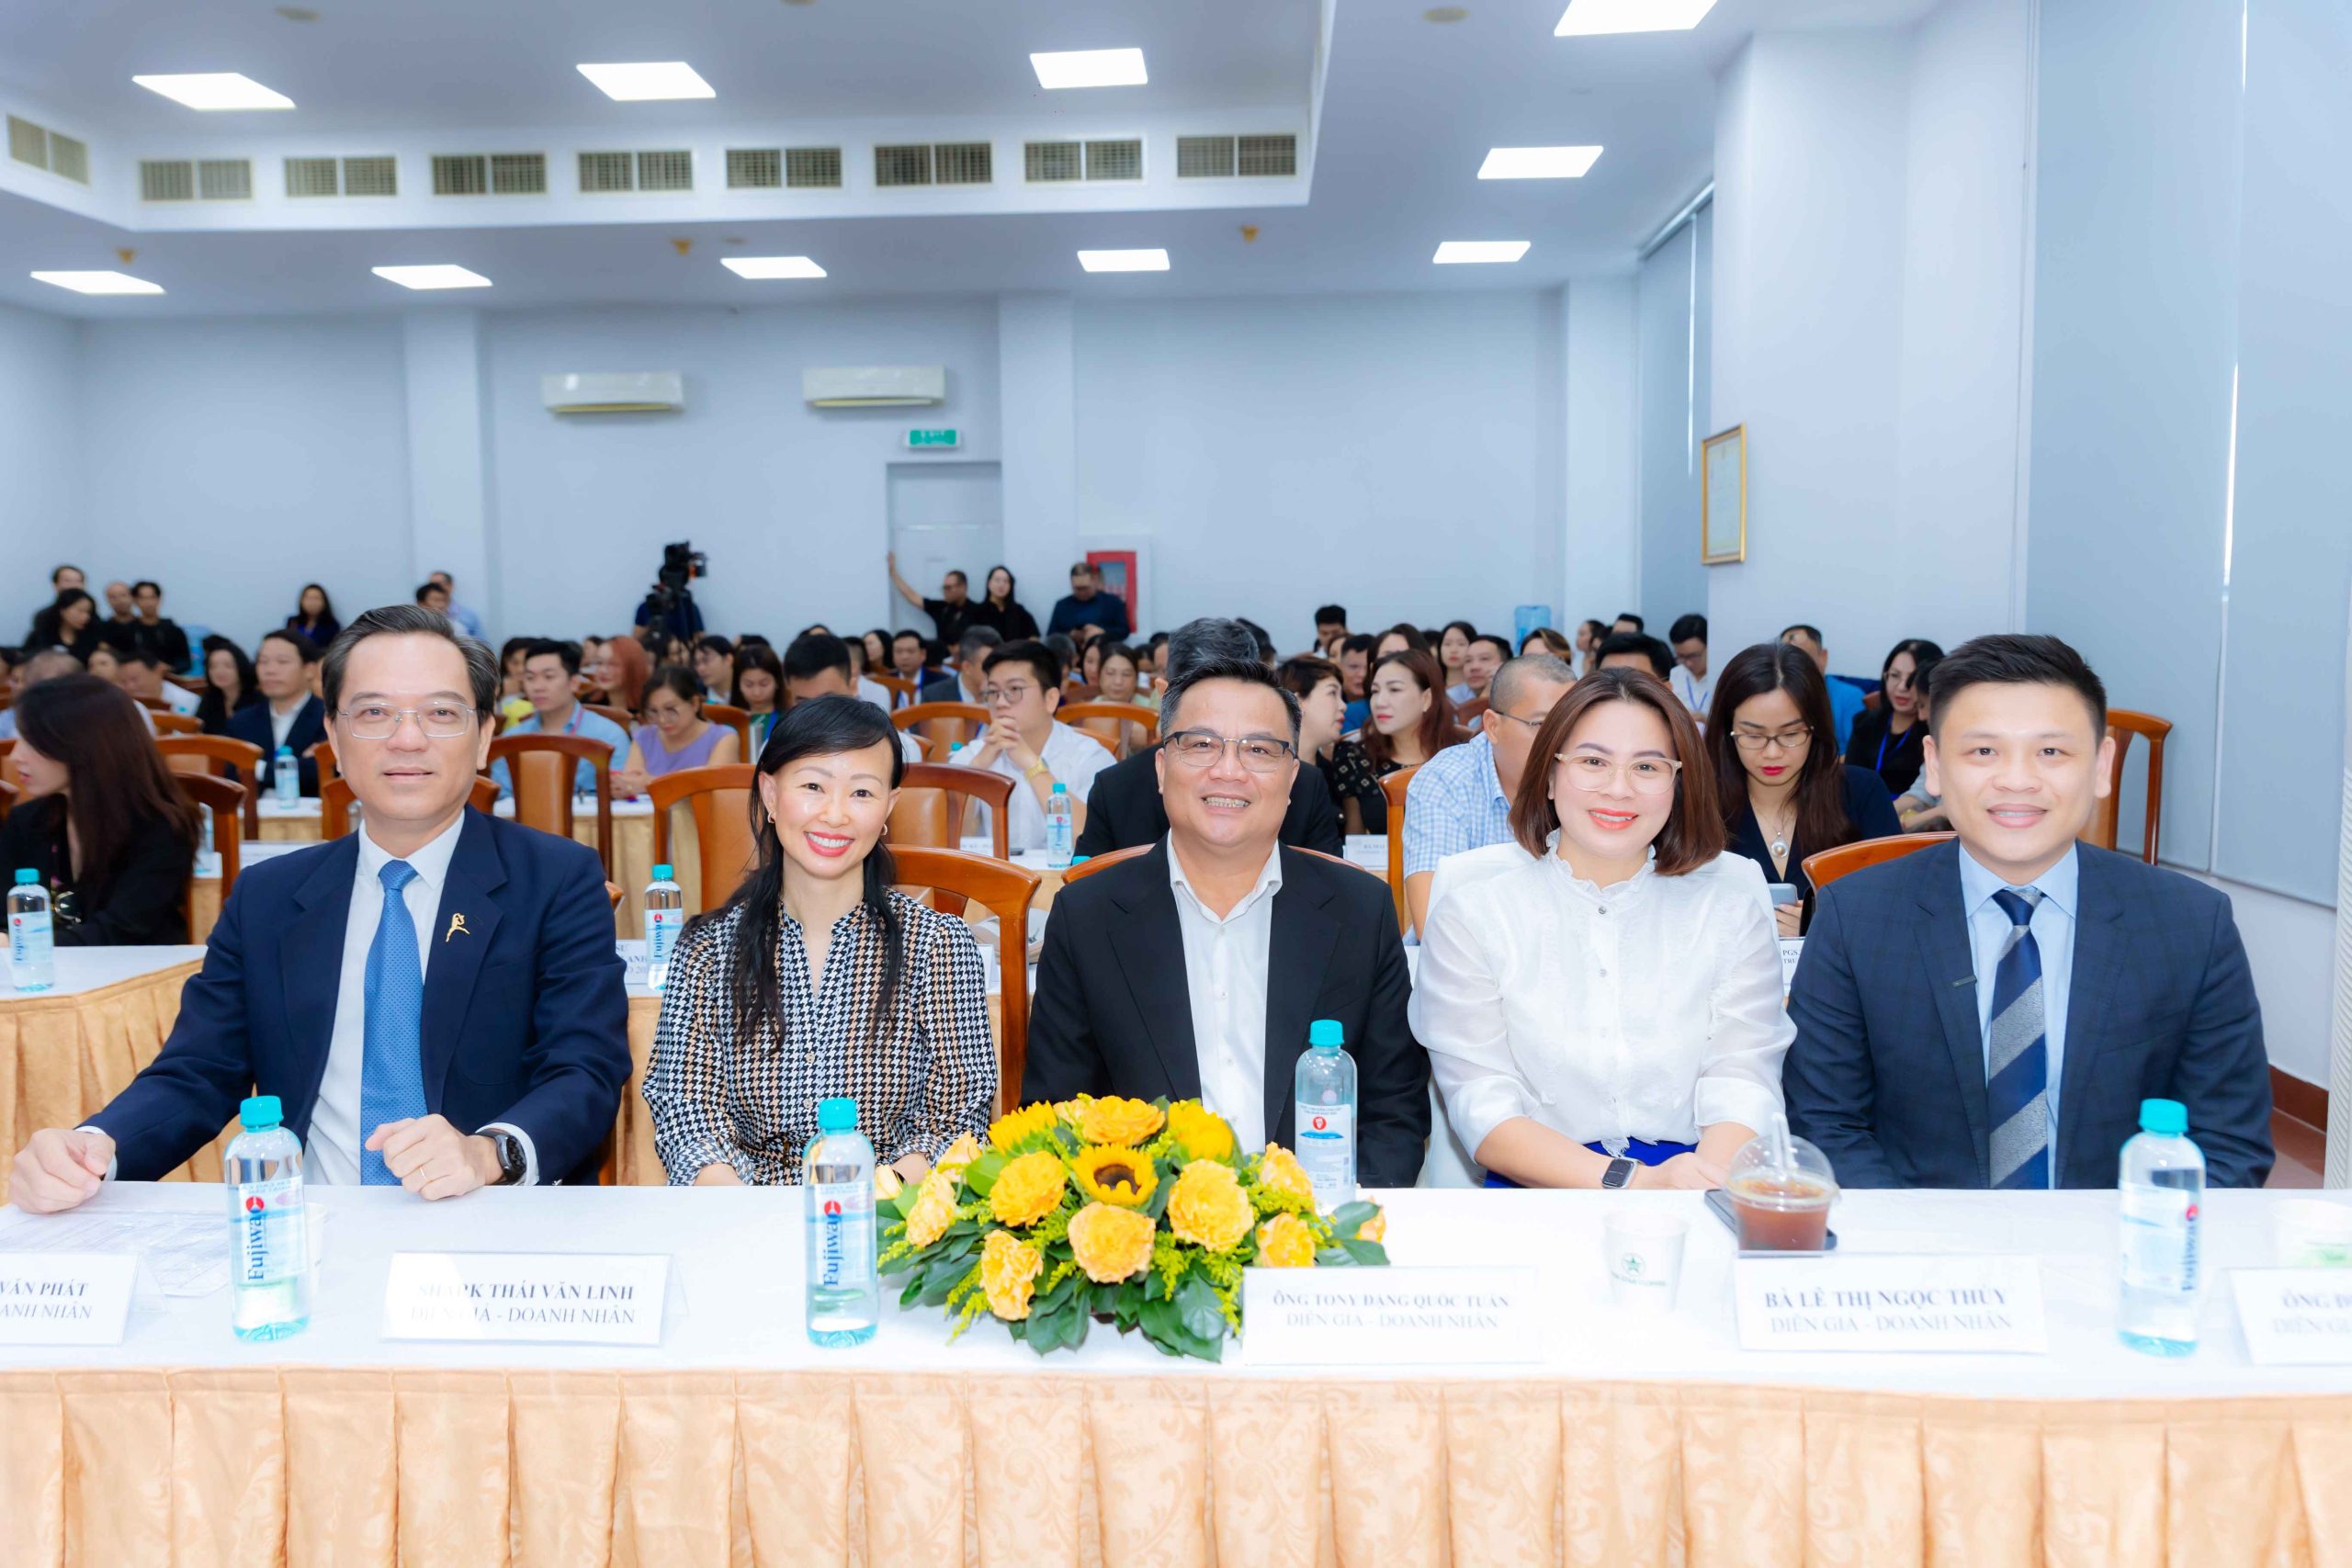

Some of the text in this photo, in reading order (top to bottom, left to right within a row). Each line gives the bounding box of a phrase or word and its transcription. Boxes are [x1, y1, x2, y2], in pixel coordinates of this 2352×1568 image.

[248, 1214, 269, 1280] Fujiwa
[823, 1220, 844, 1285] Fujiwa
[40, 1279, 89, 1296] PHÁT
[489, 1280, 536, 1299] THÁI
[542, 1280, 582, 1299] VĂN
[586, 1285, 634, 1300] LINH
[1272, 1289, 1309, 1306] ÔNG
[1315, 1292, 1359, 1306] TONY
[1799, 1286, 1827, 1308] LÊ
[1832, 1291, 1871, 1311] THỊ
[1876, 1289, 1940, 1310] NGỌC
[509, 1306, 575, 1323] DOANH
[581, 1303, 636, 1324] NHÂN
[1380, 1314, 1442, 1328] DOANH
[1875, 1314, 1948, 1330] DOANH
